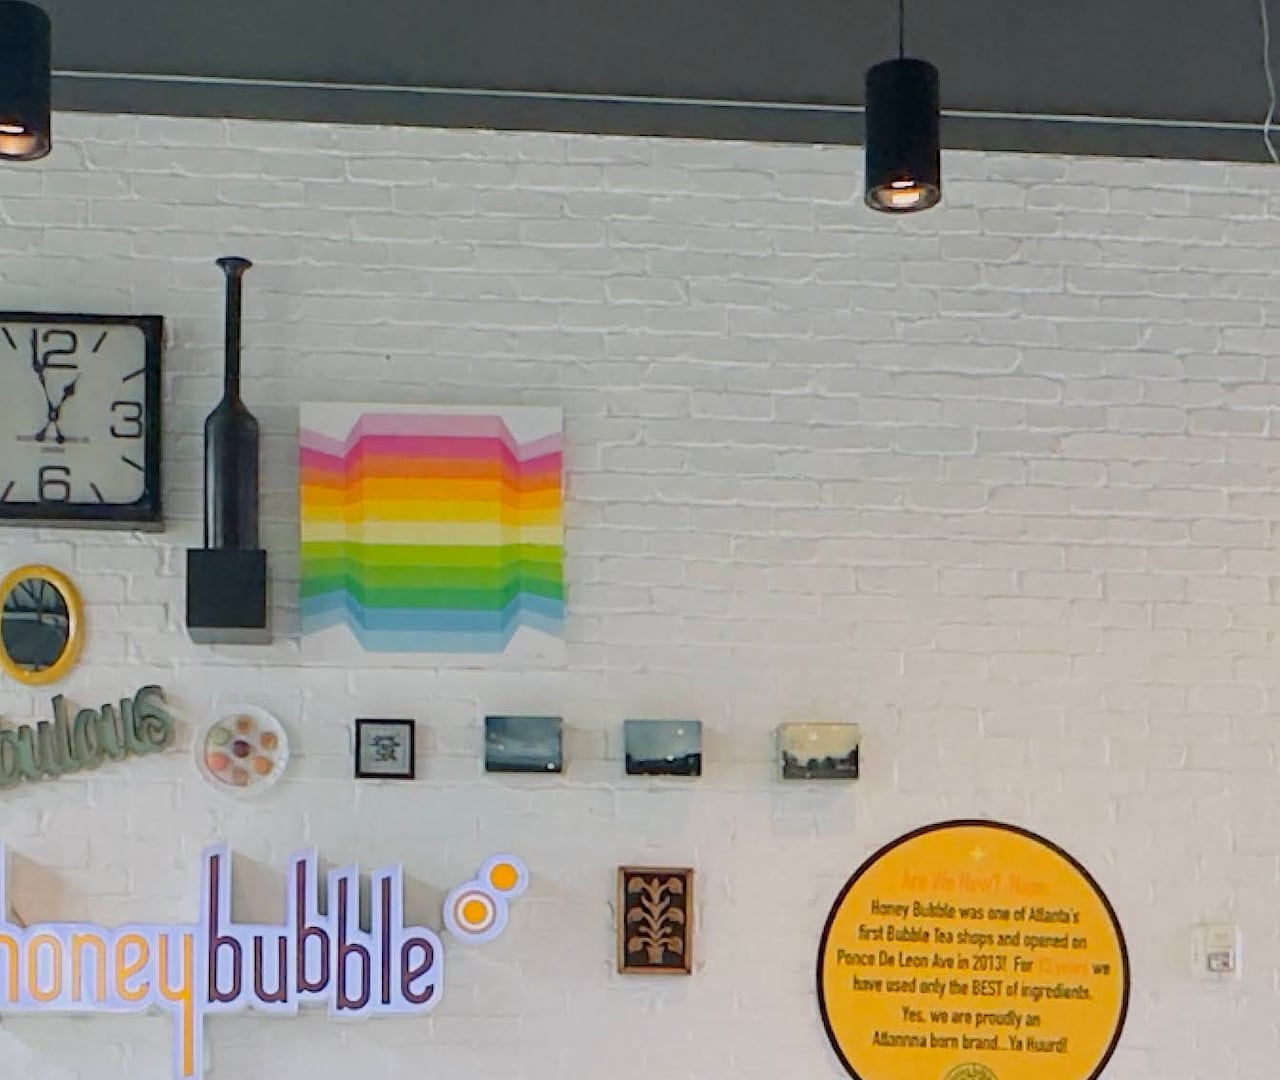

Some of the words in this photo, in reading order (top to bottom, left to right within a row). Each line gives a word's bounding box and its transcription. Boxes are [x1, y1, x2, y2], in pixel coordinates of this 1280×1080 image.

[32, 328, 78, 369] 12
[111, 401, 143, 438] 3
[39, 466, 70, 502] 6
[871, 901, 908, 919] Honey
[913, 902, 955, 919] Bubble
[959, 906, 983, 920] was
[988, 906, 1009, 921] one
[1014, 906, 1026, 922] of
[1029, 907, 1079, 923] Atlanta's
[859, 924, 883, 941] first
[887, 925, 930, 943] Bubble
[933, 928, 953, 944] Tea
[957, 930, 994, 949] shops
[997, 931, 1020, 947] and
[1024, 933, 1068, 951] opened
[1073, 936, 1087, 949] on
[838, 950, 874, 966] Ponce
[879, 951, 895, 967] De
[898, 952, 929, 968] Leon
[932, 953, 954, 969] Ave
[958, 954, 969, 969] in
[1014, 957, 1033, 973] For
[1093, 962, 1110, 975] we
[854, 977, 882, 992] have
[887, 978, 916, 993] used
[920, 979, 946, 998] only
[949, 980, 968, 996] the
[972, 980, 1002, 997] BEST
[1007, 981, 1018, 998] of
[930, 1011, 948, 1023] we
[951, 1012, 971, 1024] are
[976, 1010, 1022, 1028] proudly
[1026, 1013, 1040, 1026] an
[930, 1033, 958, 1049] born
